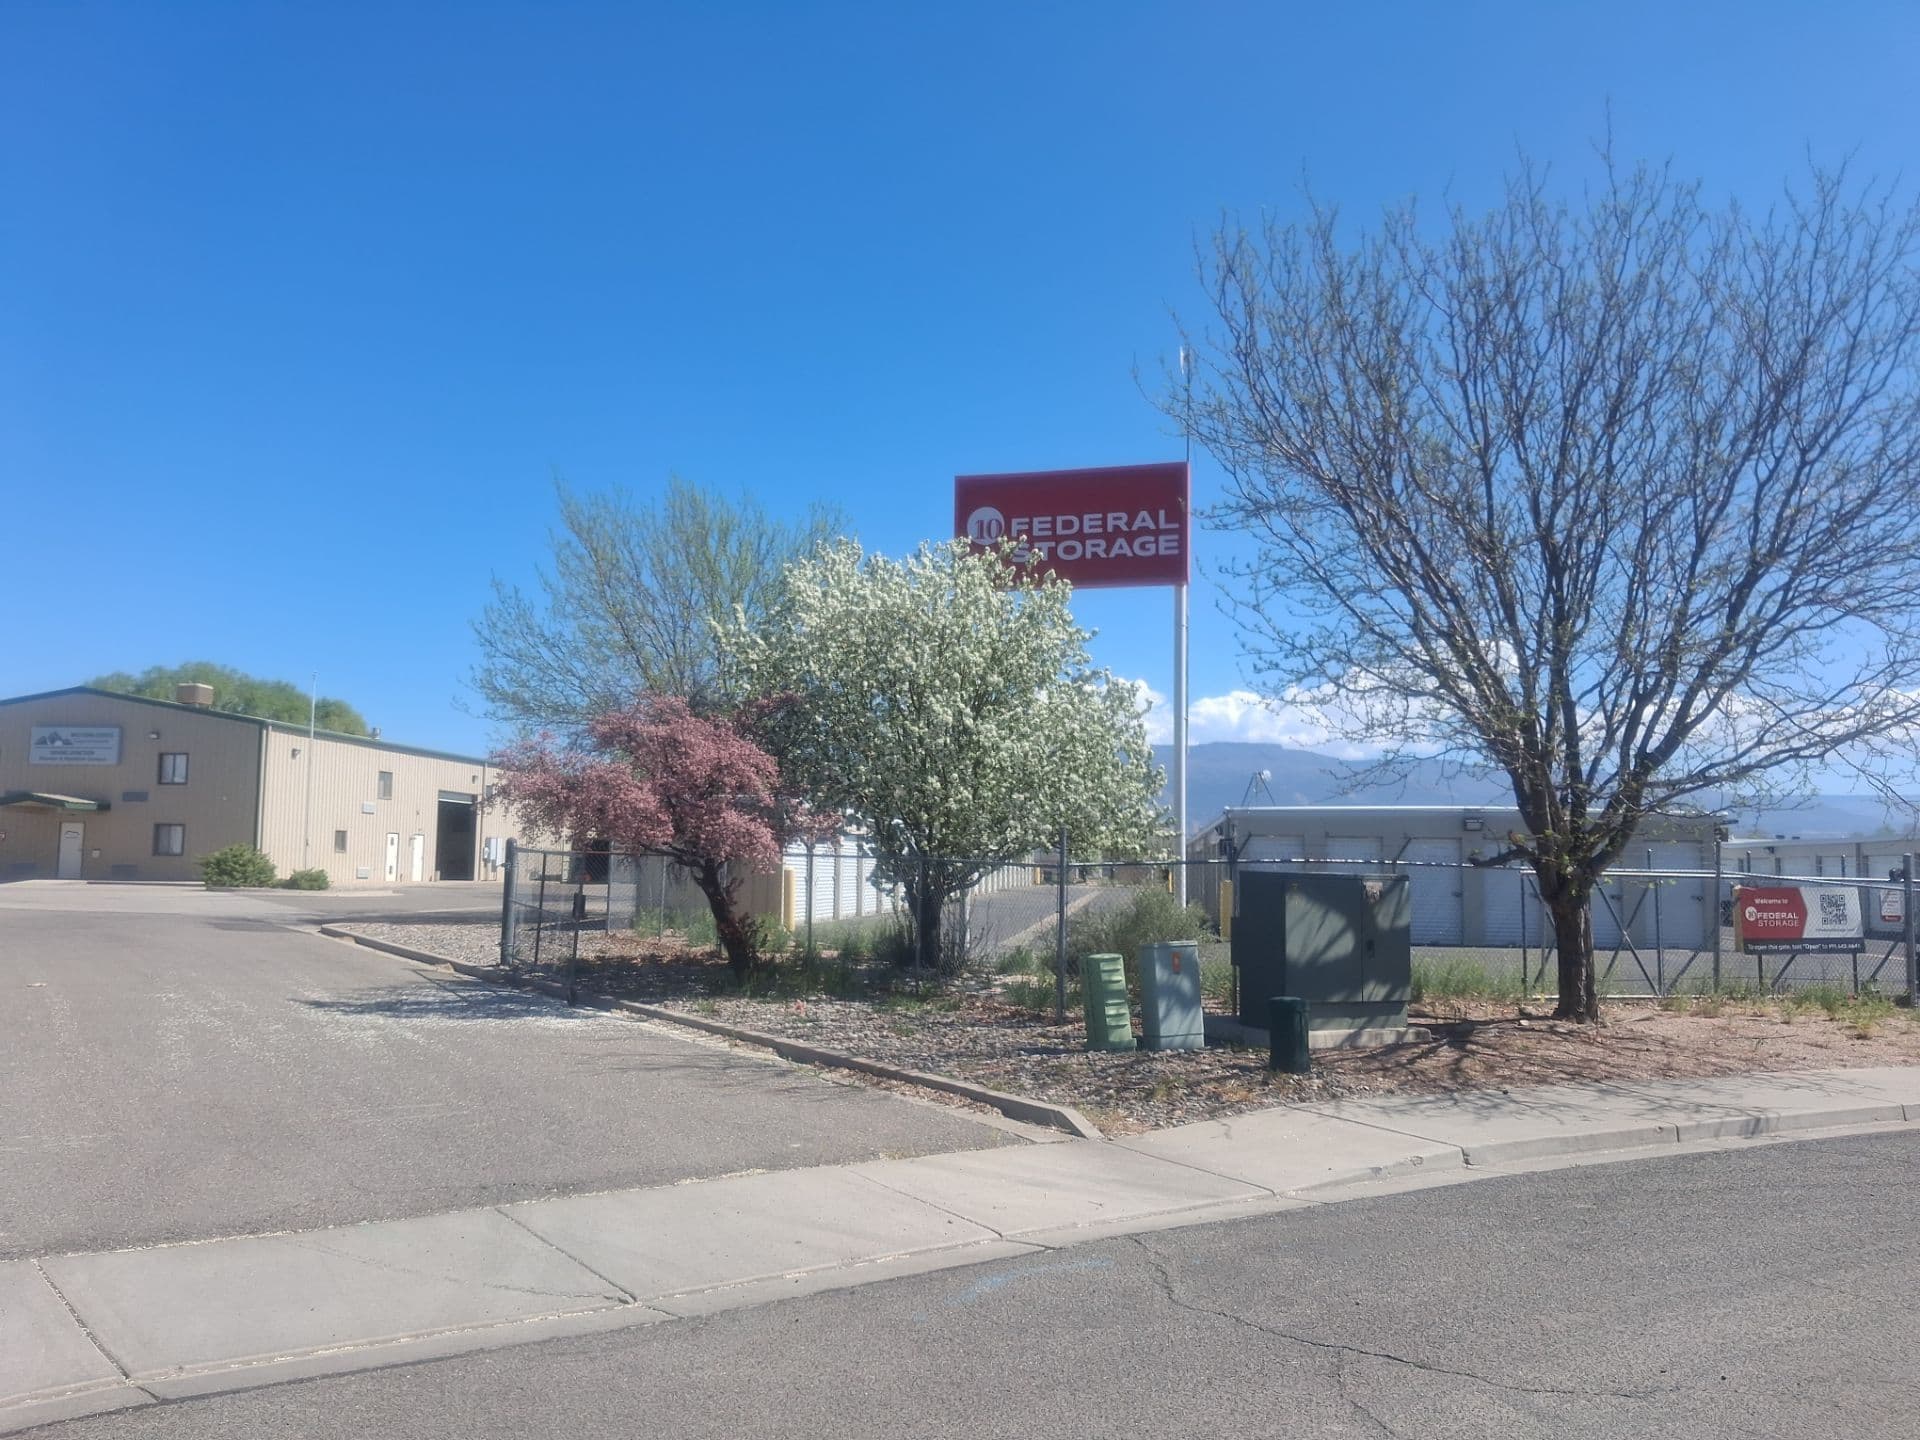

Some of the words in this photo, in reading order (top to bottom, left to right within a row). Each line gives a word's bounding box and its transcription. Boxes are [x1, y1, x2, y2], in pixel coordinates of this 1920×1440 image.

[1011, 509, 1179, 538] FEDERAL
[1012, 534, 1179, 563] STORAGE
[1757, 912, 1799, 920] FEDERAL
[1758, 919, 1800, 927] STORAGE
